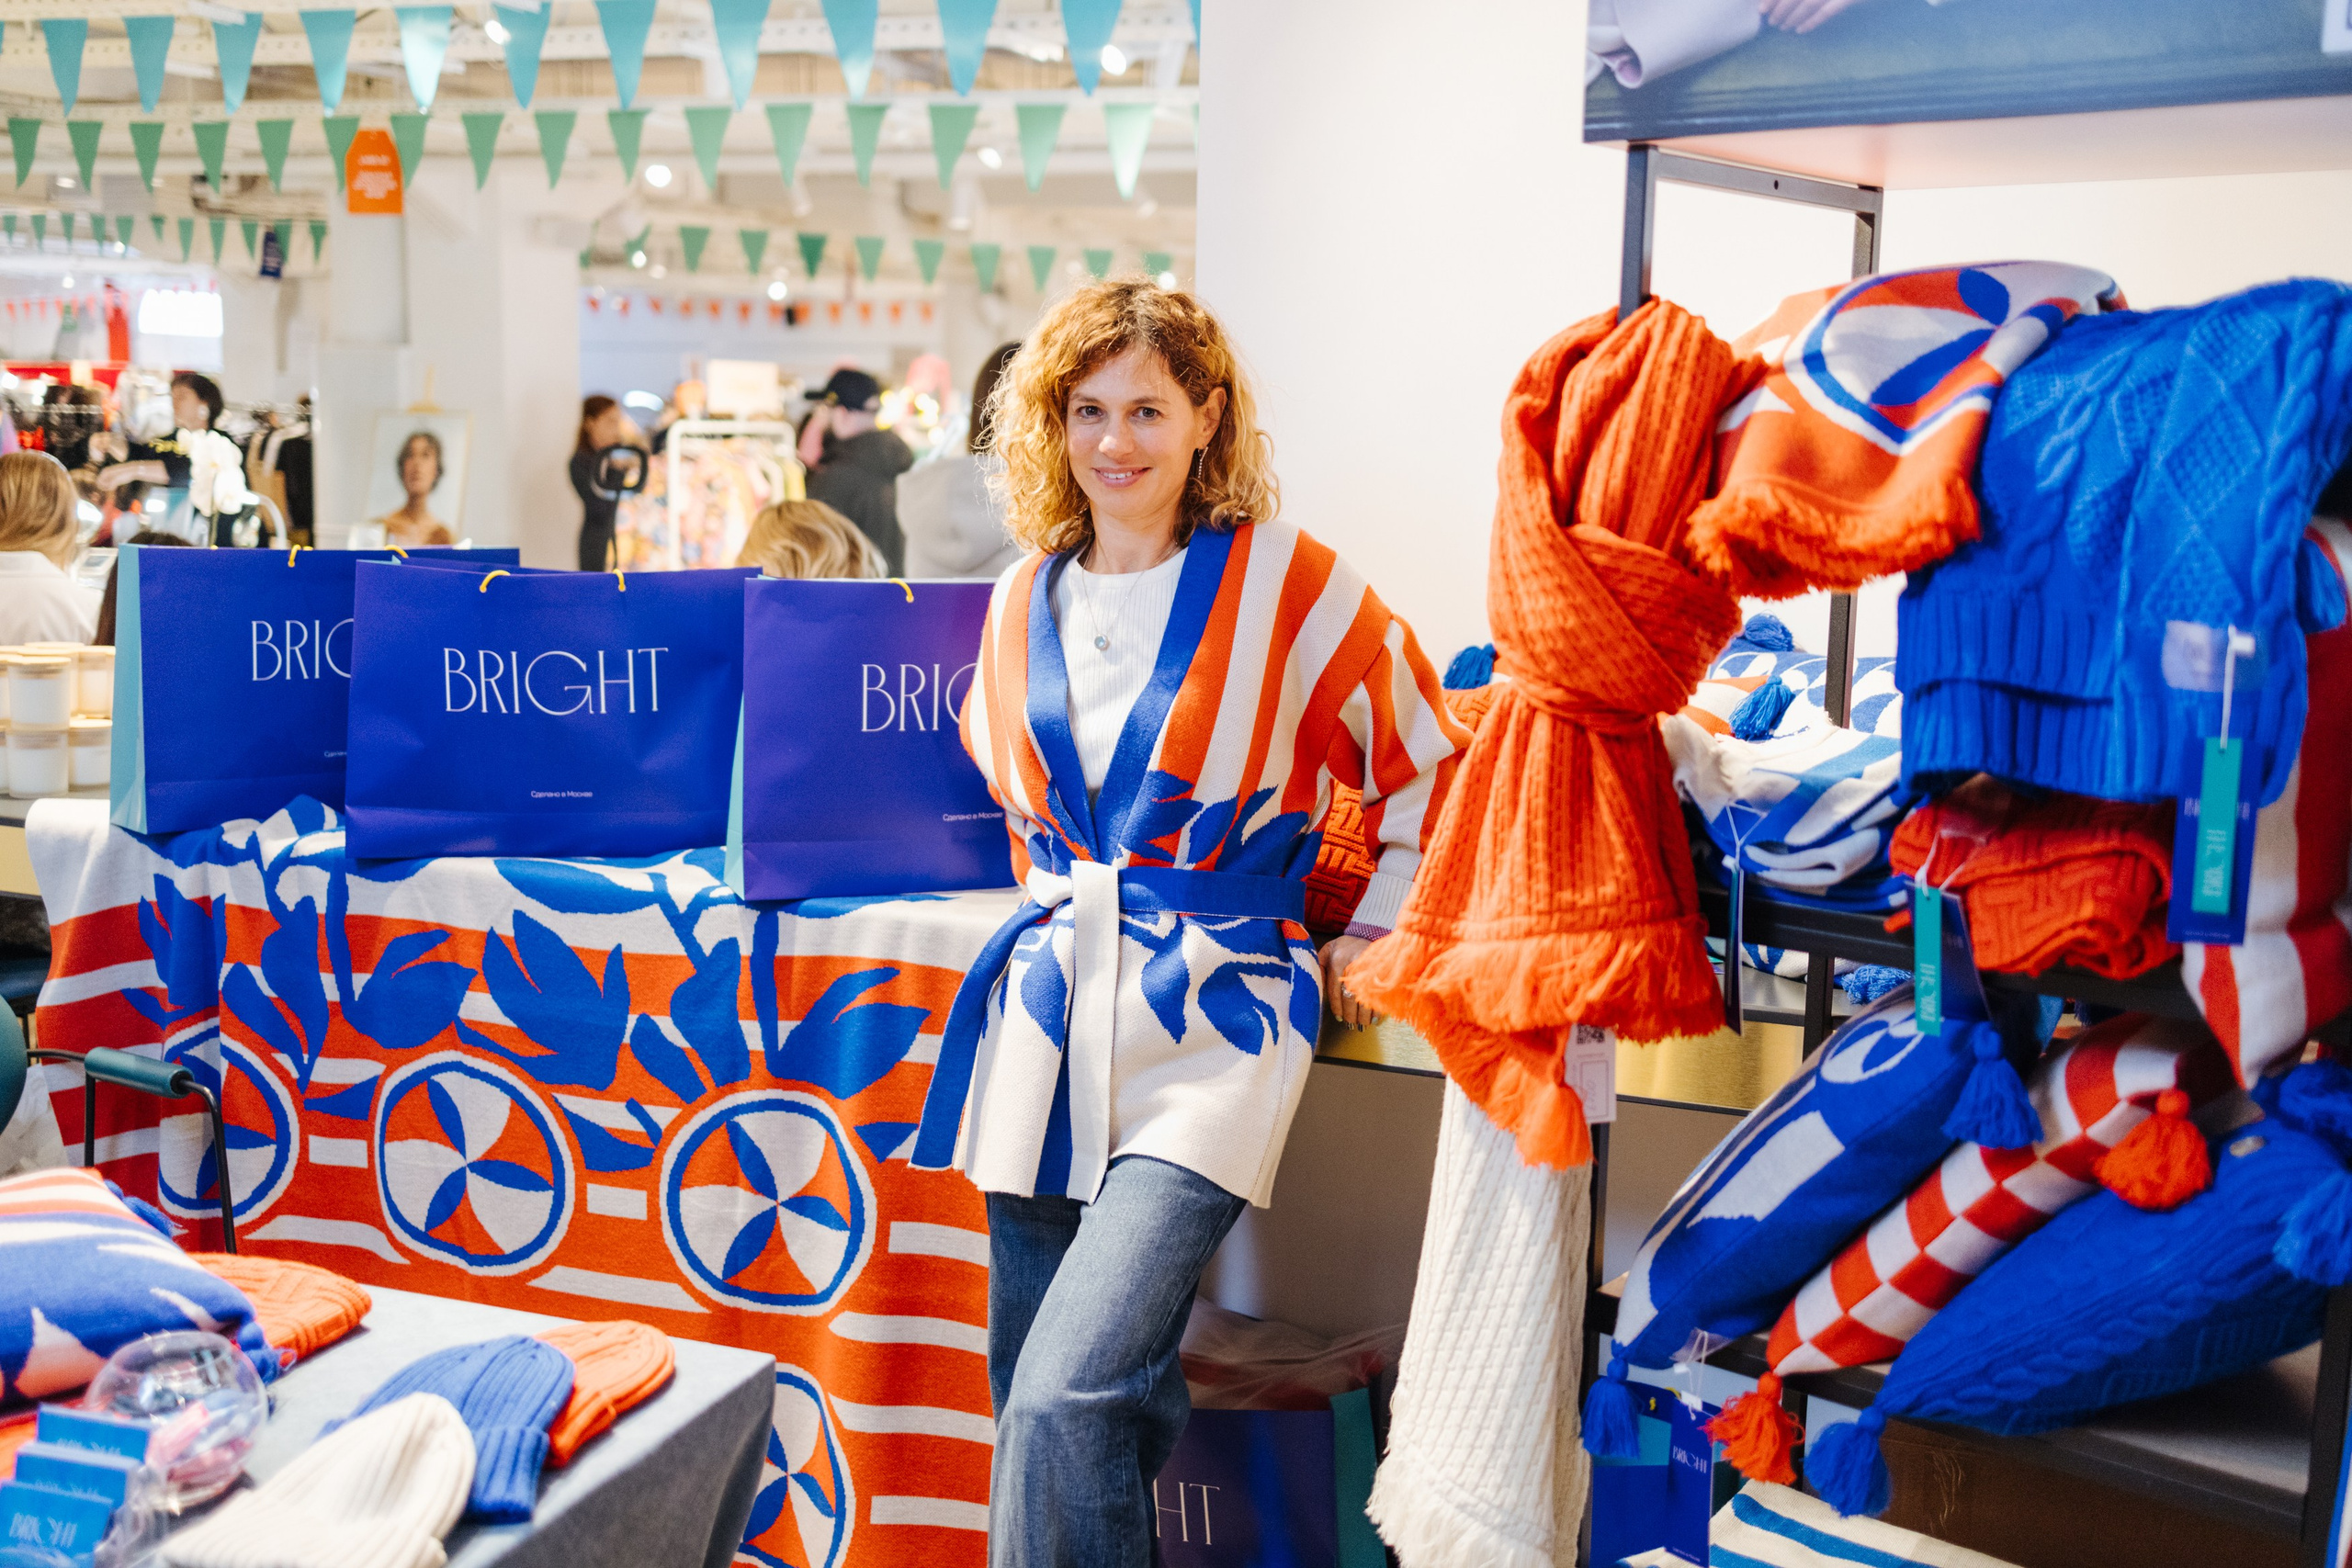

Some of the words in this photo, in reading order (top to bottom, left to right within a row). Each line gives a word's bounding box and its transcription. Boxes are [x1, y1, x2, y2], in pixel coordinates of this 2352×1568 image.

[444, 647, 669, 716] BRIGHT
[530, 789, 560, 799] Сделано
[567, 789, 594, 798] Москве
[943, 813, 972, 822] Сделано
[978, 811, 1003, 819] Москве
